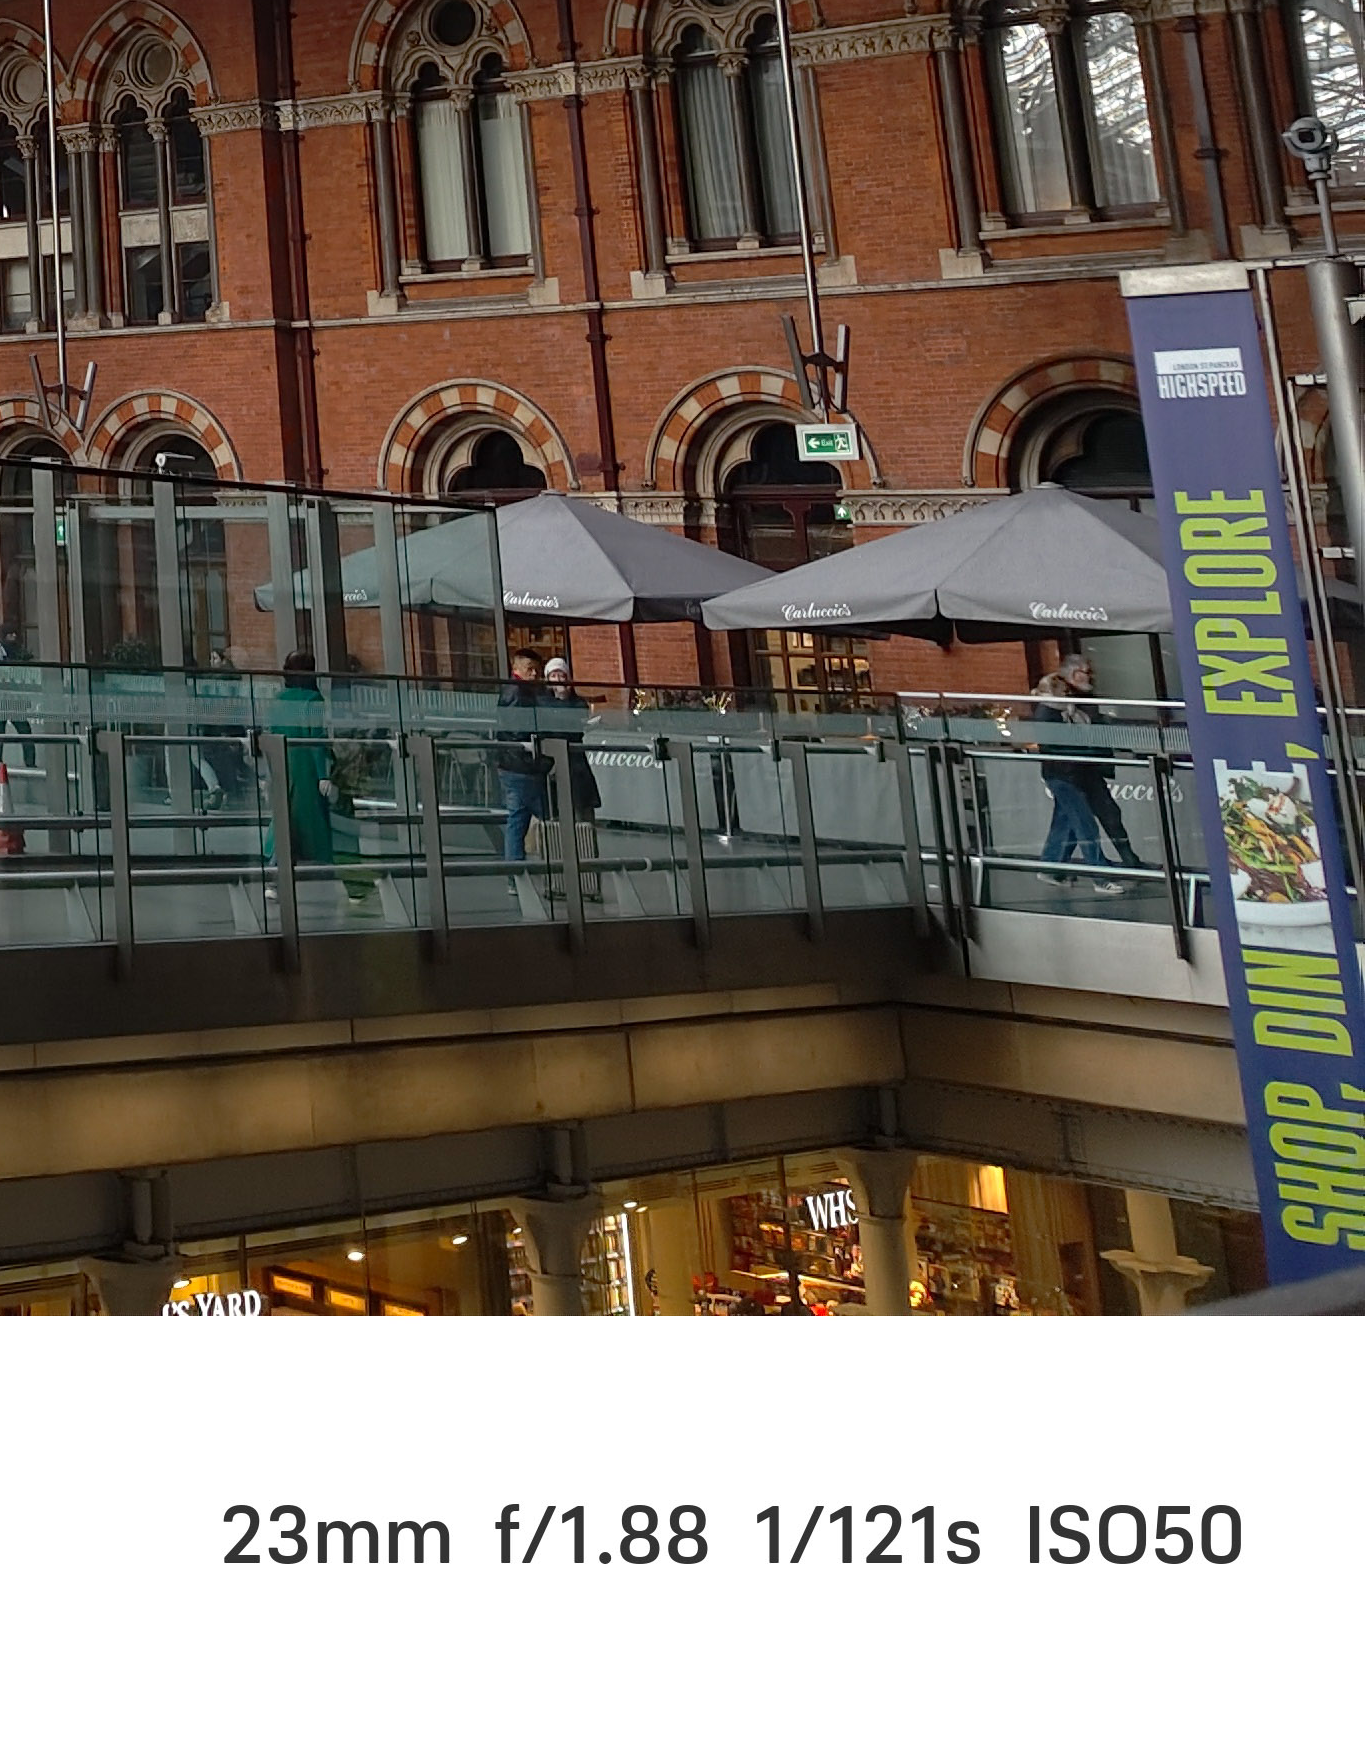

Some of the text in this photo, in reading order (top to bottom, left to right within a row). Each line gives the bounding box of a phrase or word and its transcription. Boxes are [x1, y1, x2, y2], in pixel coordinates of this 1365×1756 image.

[1156, 372, 1247, 399] HIGHSPEED
[503, 590, 559, 608] Carluccio's
[781, 602, 852, 621] Carluccio's
[1029, 601, 1108, 621] Carluccio's
[1175, 490, 1297, 717] EXPLORE
[1264, 1081, 1365, 1251] SHOP,
[194, 1289, 262, 1316] YARD
